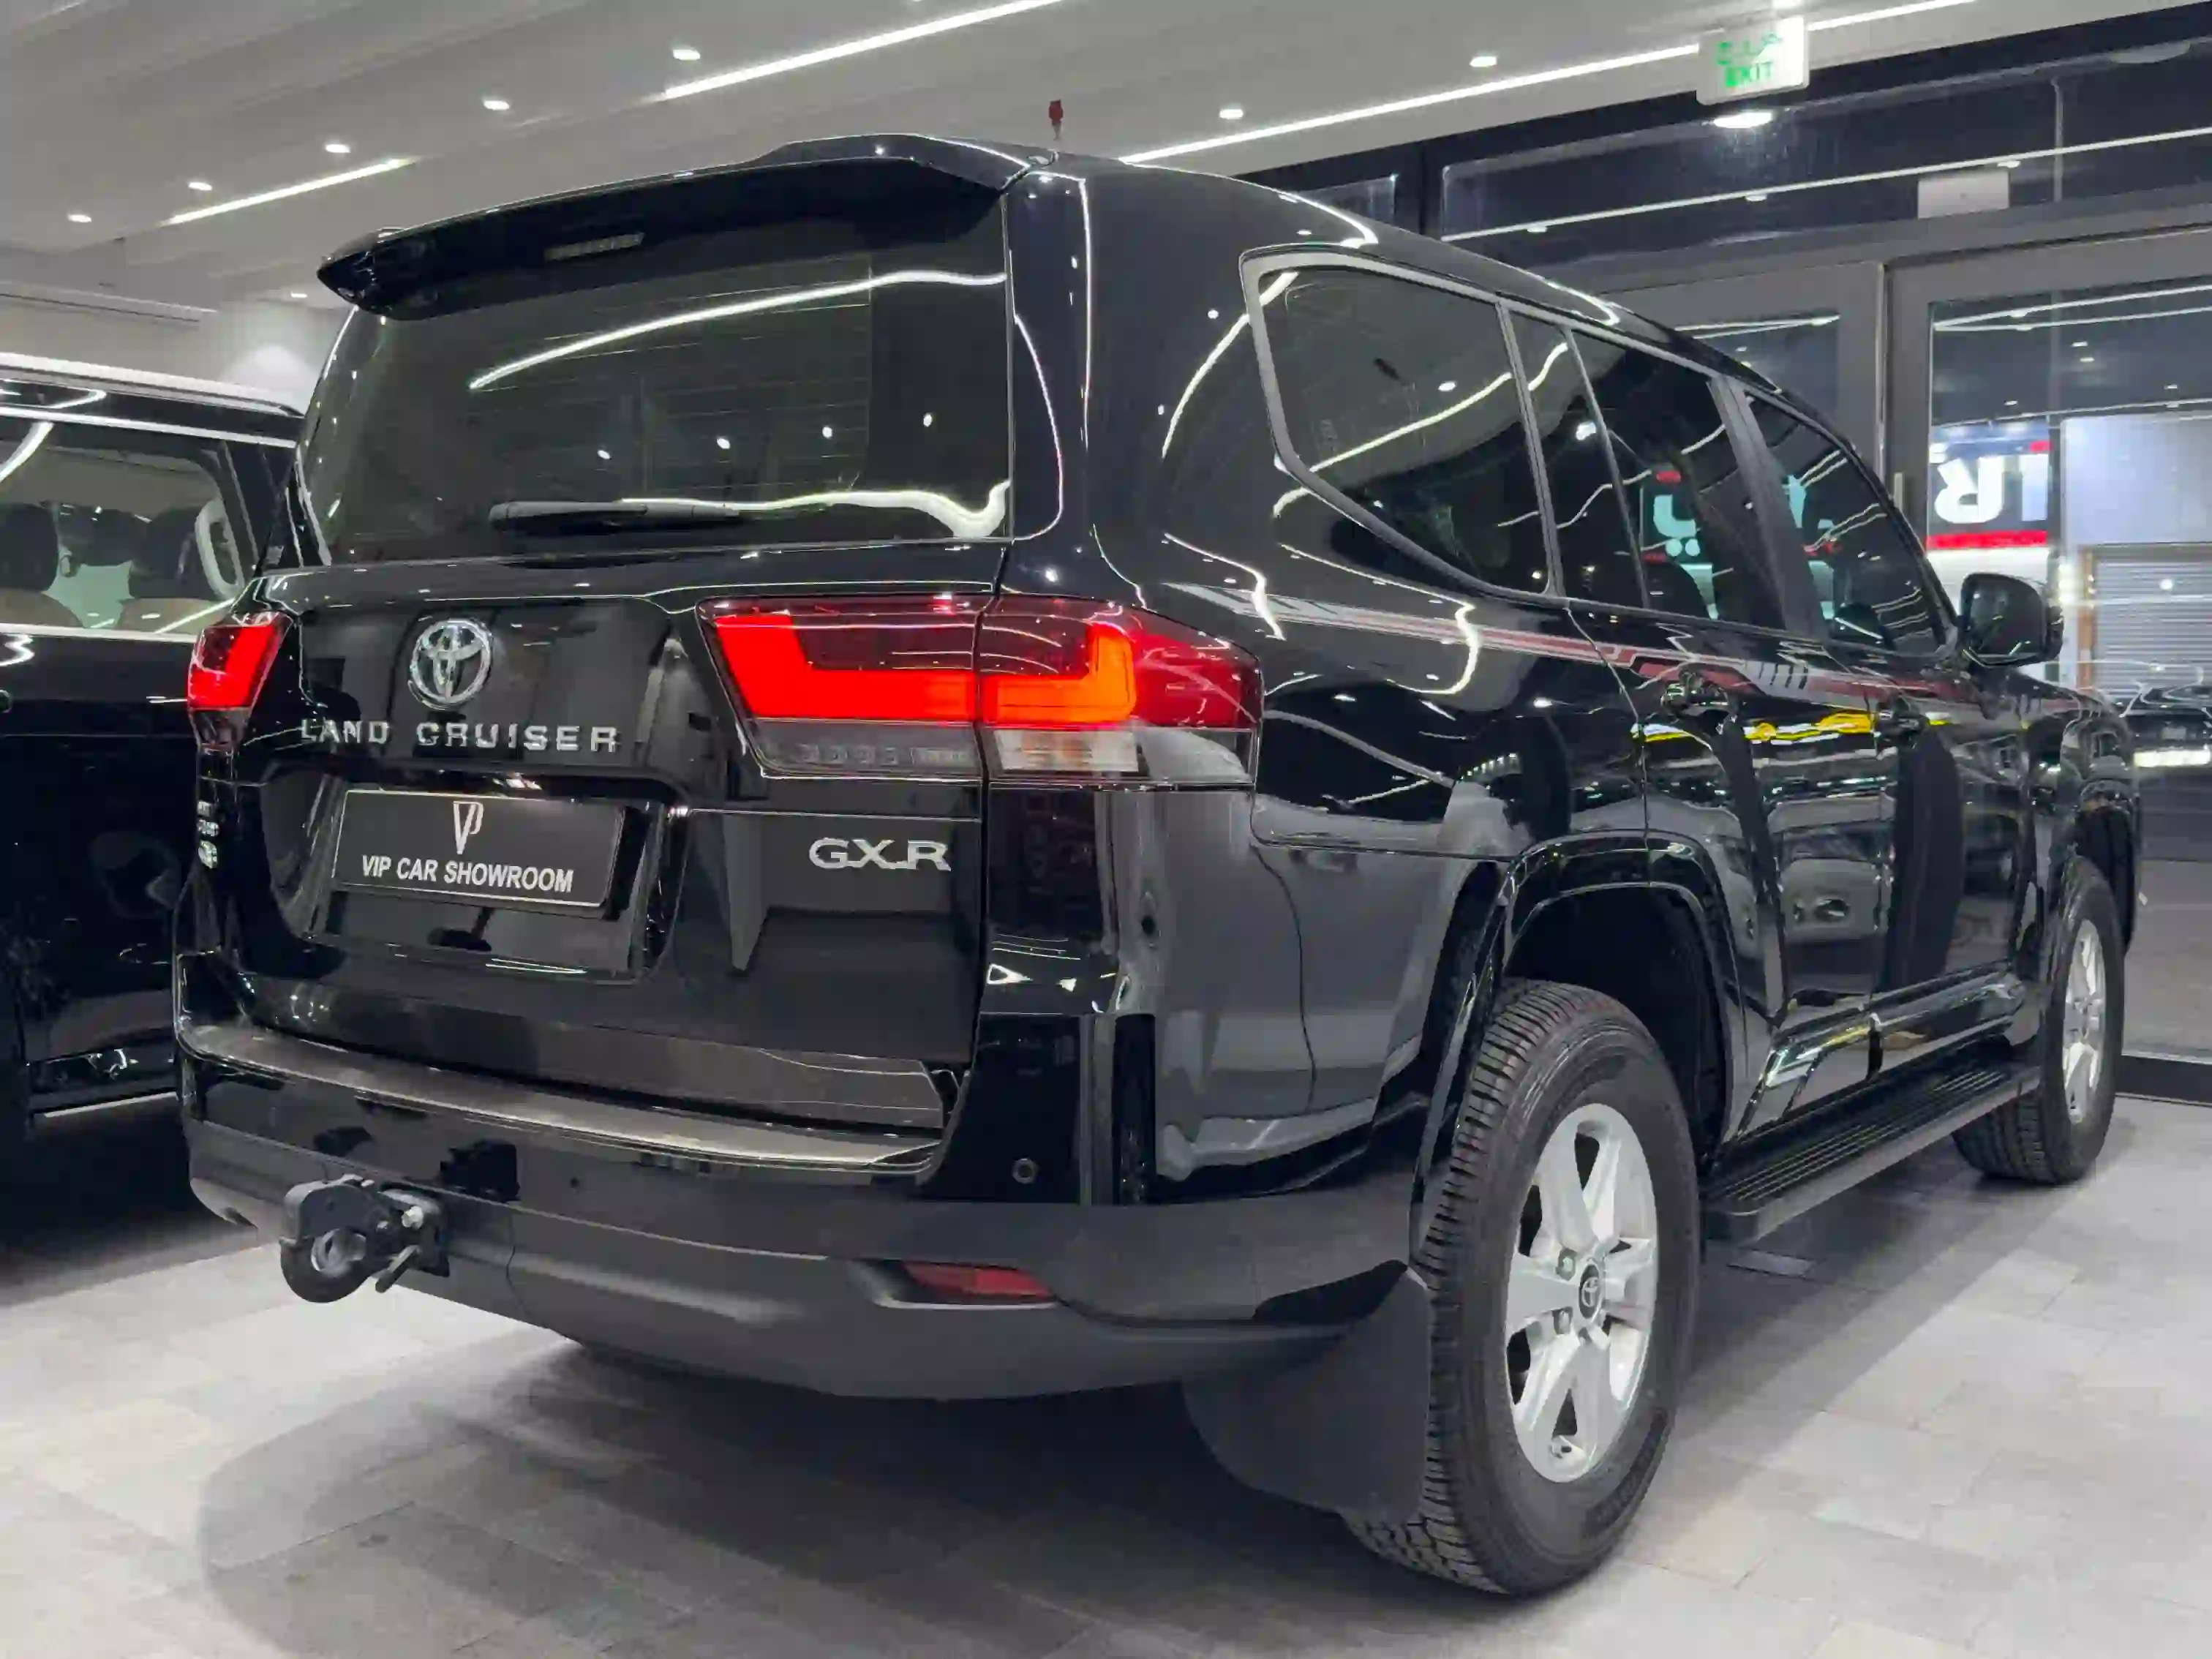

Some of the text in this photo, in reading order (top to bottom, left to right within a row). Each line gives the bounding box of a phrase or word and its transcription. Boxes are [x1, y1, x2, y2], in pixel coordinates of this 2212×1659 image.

[301, 719, 617, 753] LAND CRUISER
[809, 837, 952, 871] GXR
[361, 854, 574, 892] VIP CAR SHOWROOM
